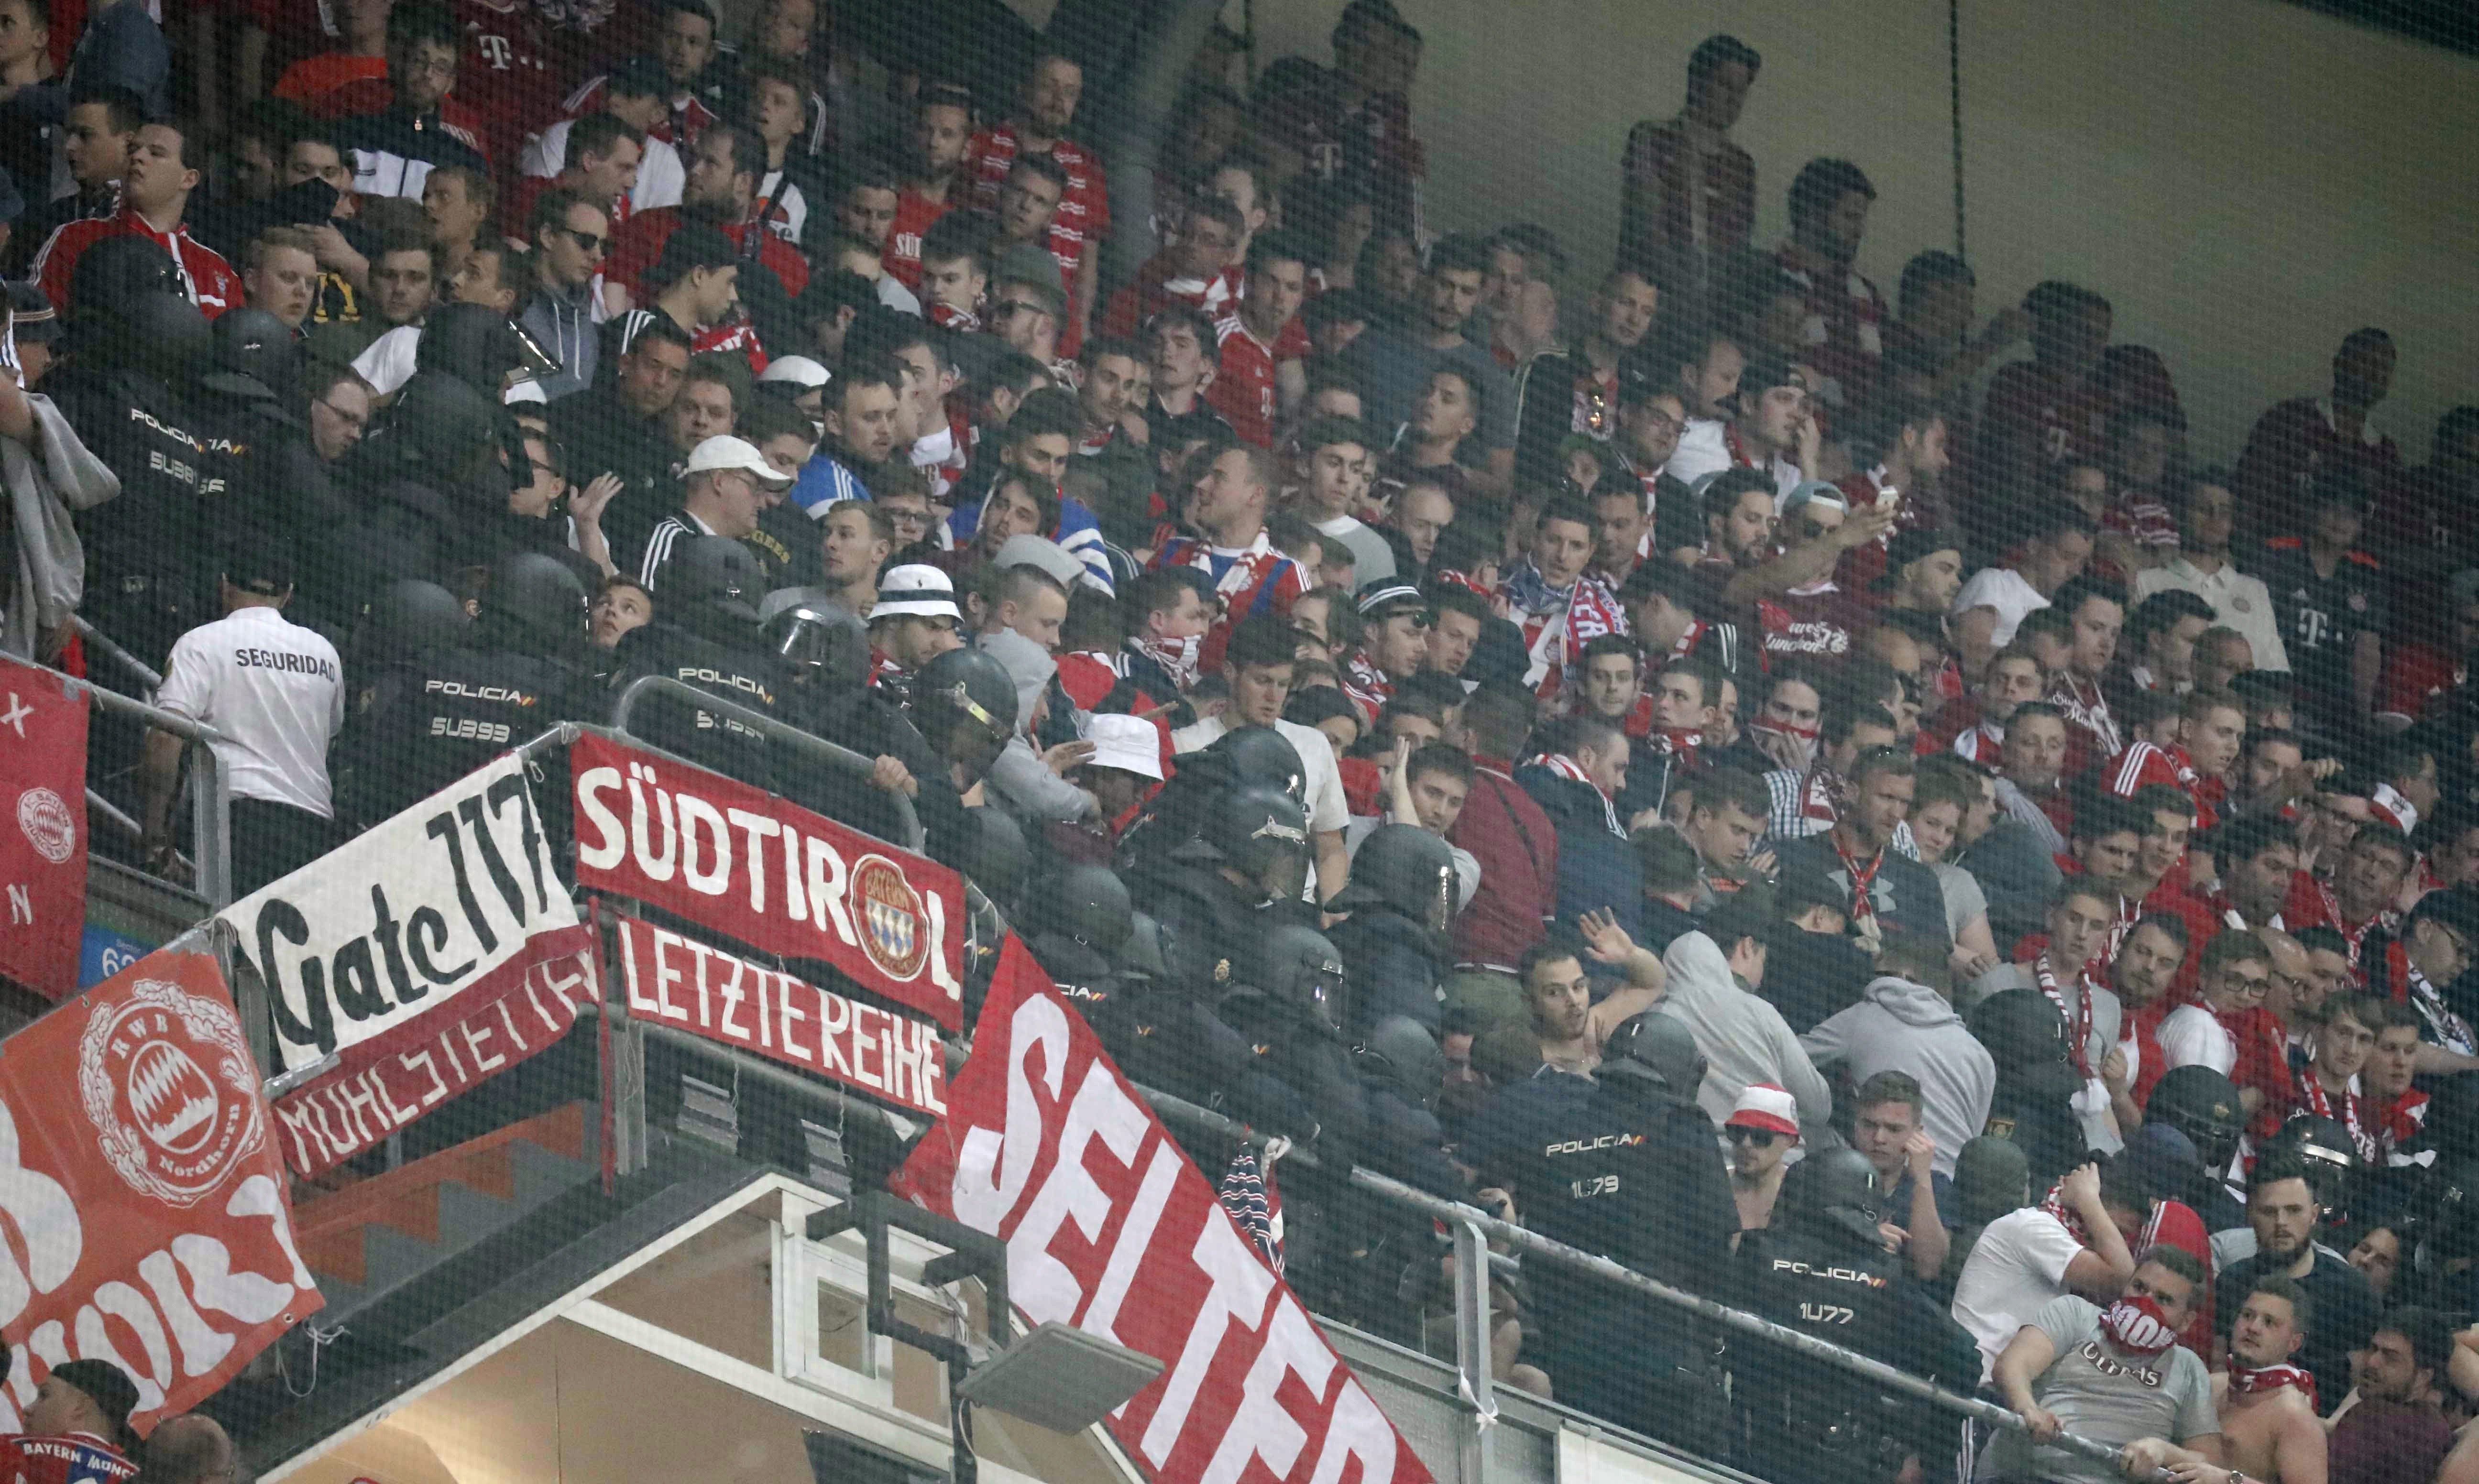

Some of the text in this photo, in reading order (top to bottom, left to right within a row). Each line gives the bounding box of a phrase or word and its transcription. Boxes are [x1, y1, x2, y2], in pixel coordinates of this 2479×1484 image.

[235, 648, 335, 683] SEGURIDAD
[425, 680, 522, 703] POLICIA
[678, 667, 767, 701] POLICIA
[256, 883, 478, 1054] Gate
[159, 1104, 240, 1177] Nordhorn
[1546, 1133, 1633, 1157] POLICIA
[1773, 1259, 1872, 1286] POLICIA
[1799, 1302, 1854, 1324] 1U77
[22, 1442, 82, 1463] BAYERN
